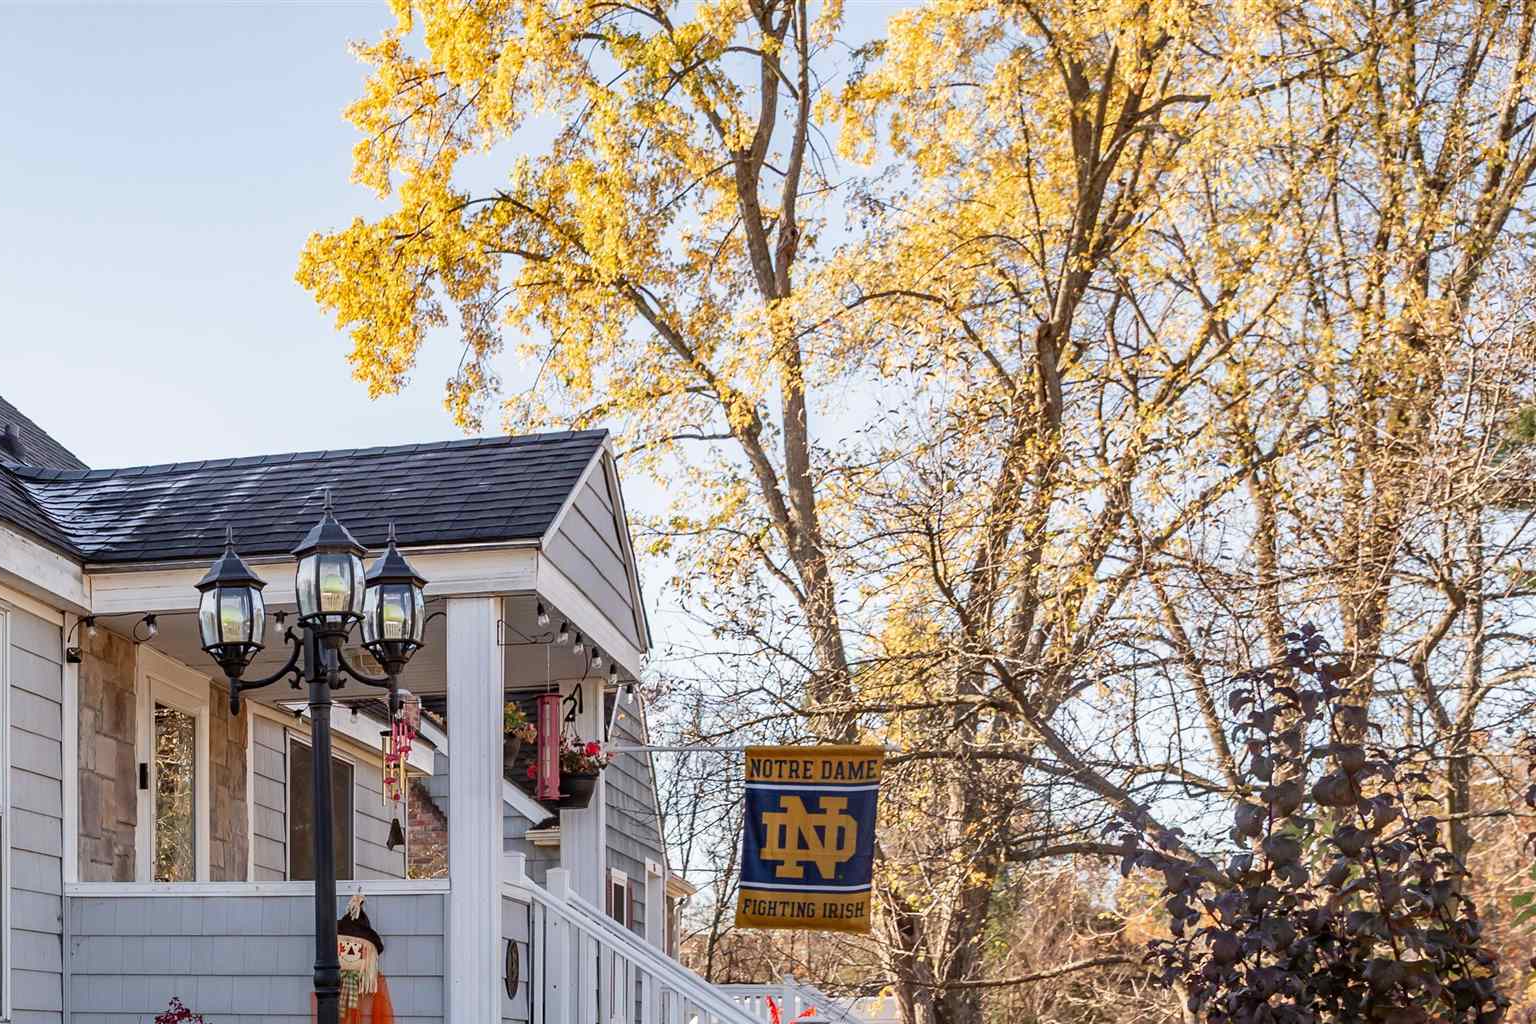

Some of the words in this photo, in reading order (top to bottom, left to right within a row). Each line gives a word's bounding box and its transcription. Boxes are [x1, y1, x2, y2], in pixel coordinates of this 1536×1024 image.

[750, 758, 814, 779] NOTRE
[820, 759, 877, 780] DAME
[742, 898, 816, 918] FIGHTING
[822, 900, 865, 919] IRISH
